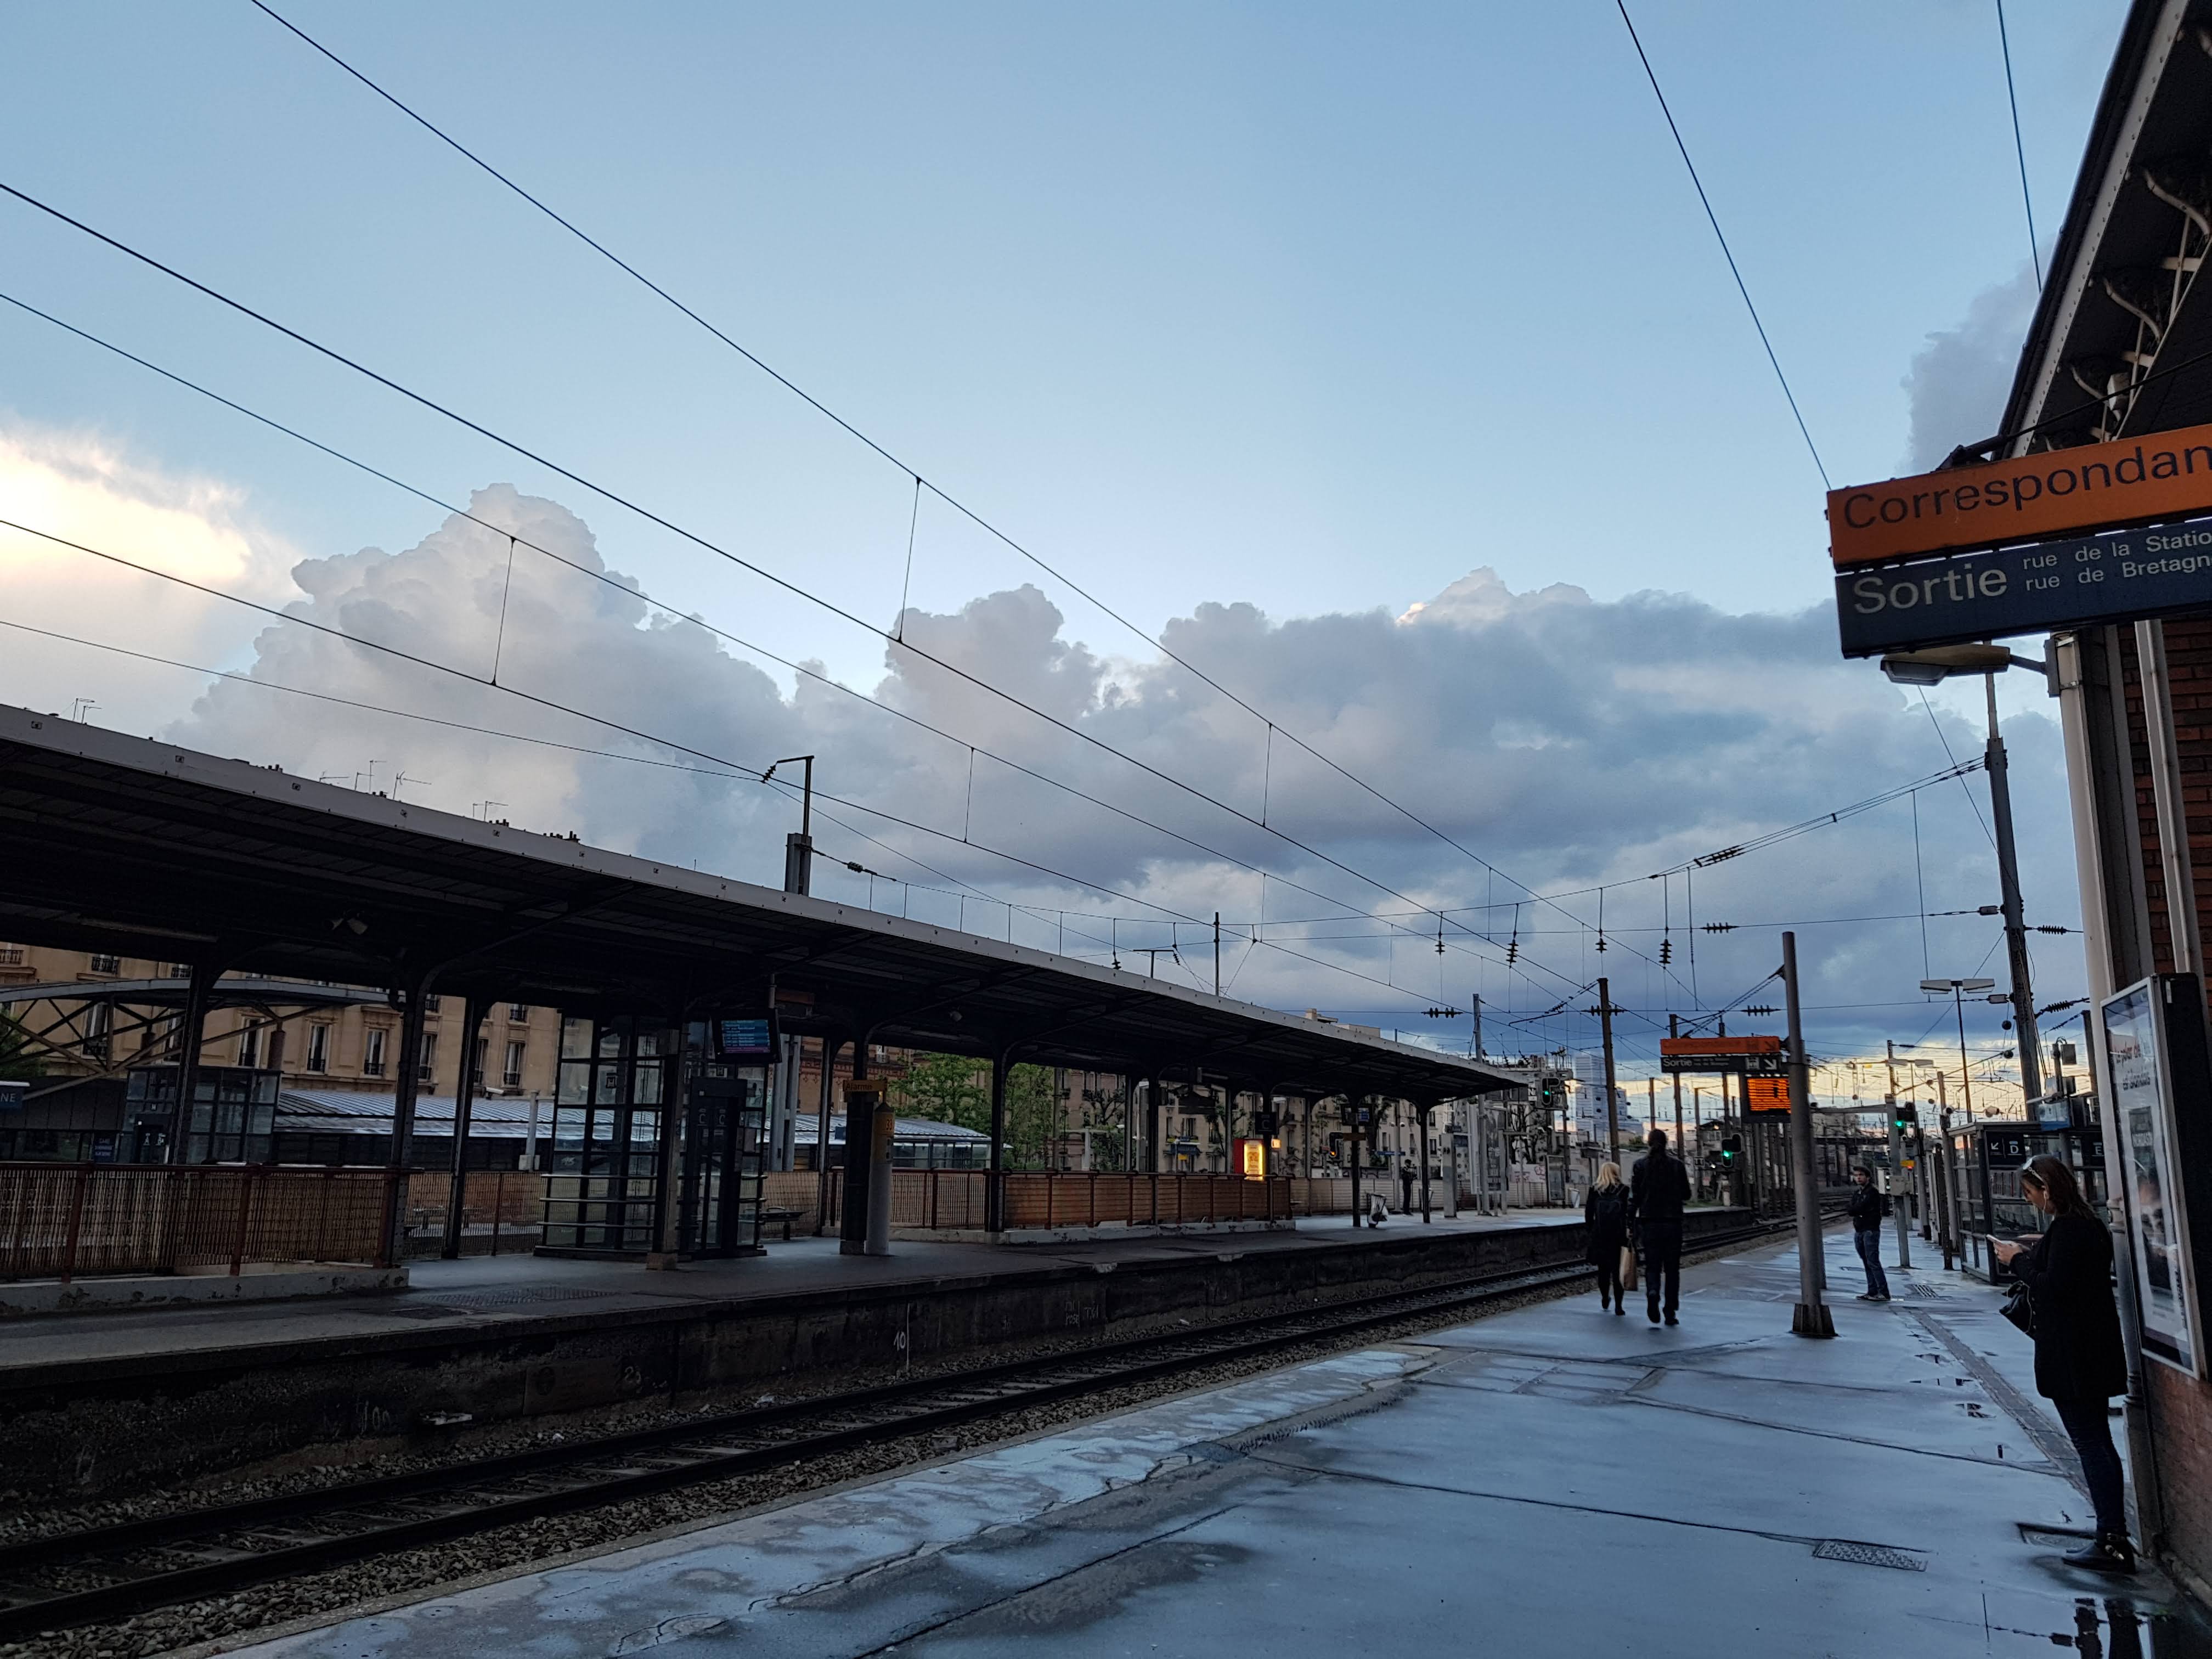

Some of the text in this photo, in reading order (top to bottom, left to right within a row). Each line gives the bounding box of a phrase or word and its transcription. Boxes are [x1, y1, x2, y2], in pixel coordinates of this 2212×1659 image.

[1844, 445, 2212, 528] Correspondan
[2023, 531, 2212, 570] rue de la Statio
[2025, 554, 2212, 591] rue de Bretagn
[1853, 563, 2007, 614] Sortie
[1663, 1058, 1692, 1067] Sortie
[845, 1082, 873, 1091] Alarme
[2010, 1145, 2019, 1154] D
[893, 1330, 906, 1352] 10
